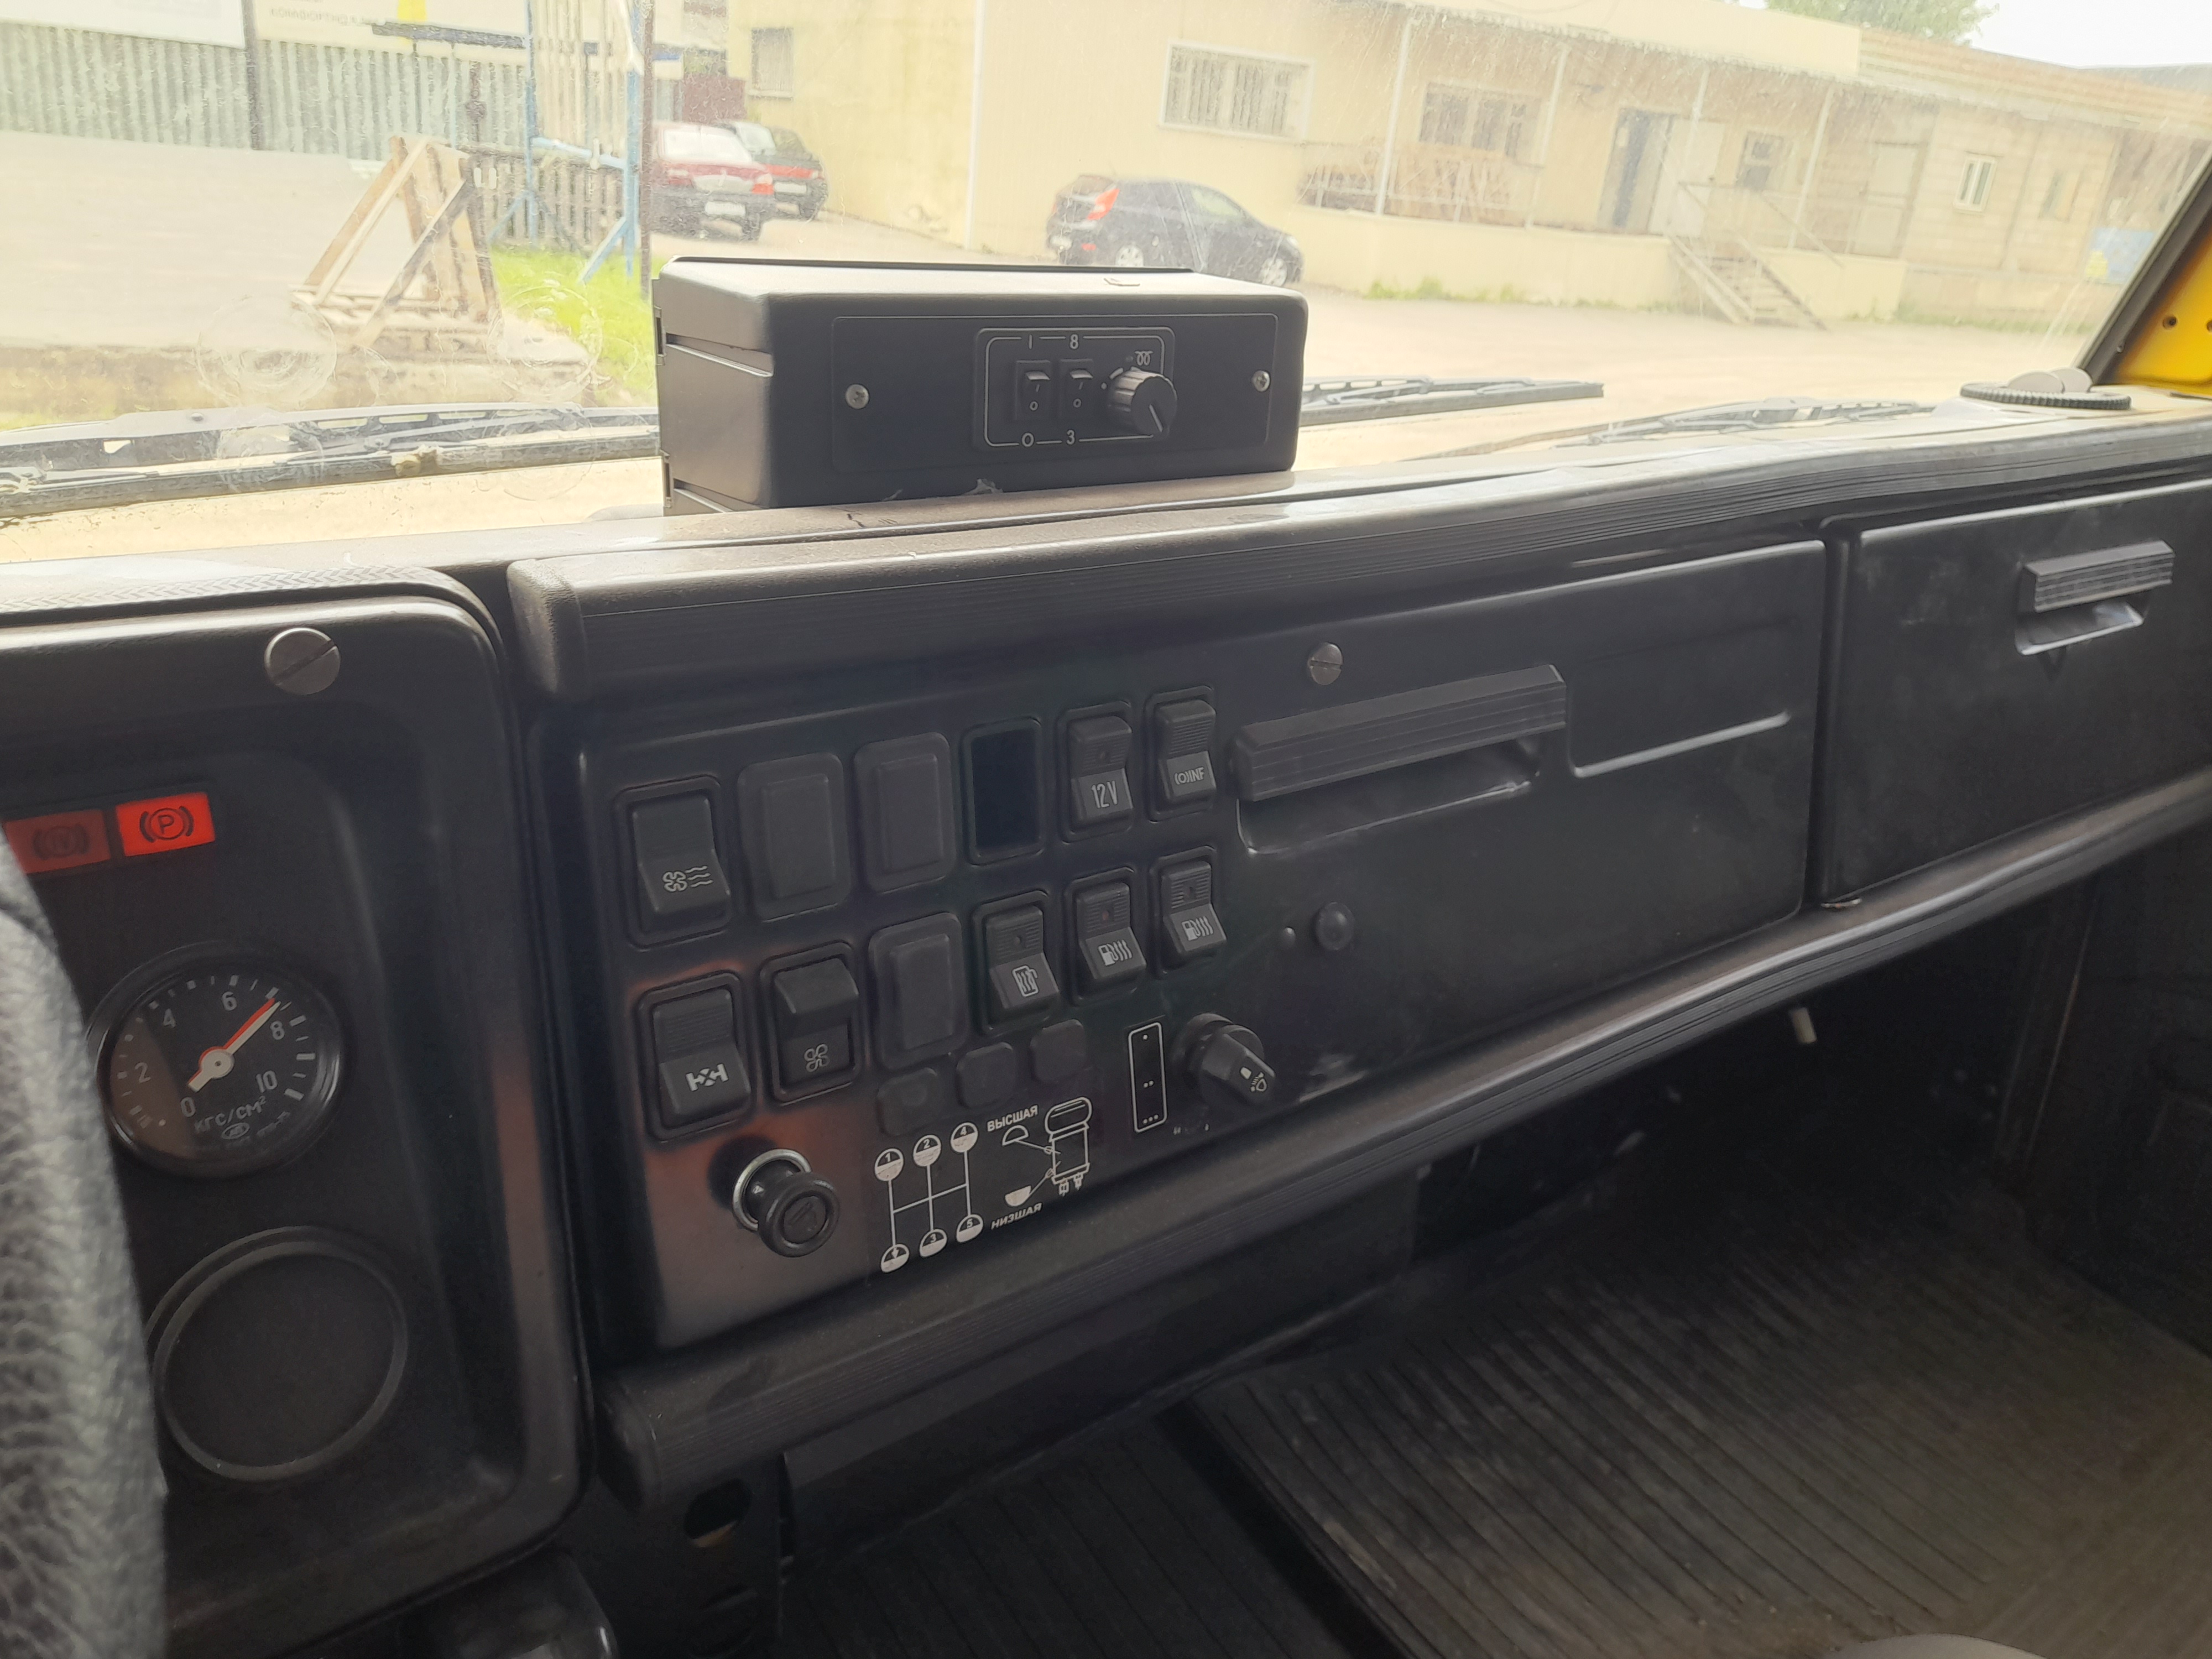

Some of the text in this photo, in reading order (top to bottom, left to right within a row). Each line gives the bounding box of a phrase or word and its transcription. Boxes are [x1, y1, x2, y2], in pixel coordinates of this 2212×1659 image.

[1069, 334, 1079, 349] 8
[1066, 430, 1076, 445] 3
[1091, 780, 1118, 808] 12V
[158, 814, 174, 833] P
[222, 992, 237, 1011] 6
[163, 1008, 176, 1028] 4
[269, 1021, 285, 1040] 8
[134, 1062, 152, 1084] 2
[255, 1070, 278, 1093] 10
[180, 1097, 196, 1118] 0
[987, 1105, 1039, 1133] ВЫСШАЯ
[960, 1126, 967, 1136] 4
[923, 1139, 931, 1149] 2
[885, 1153, 891, 1162] 1
[966, 1219, 973, 1229] 5
[990, 1202, 1043, 1230] НИЗШАЯ
[930, 1234, 937, 1243] 3
